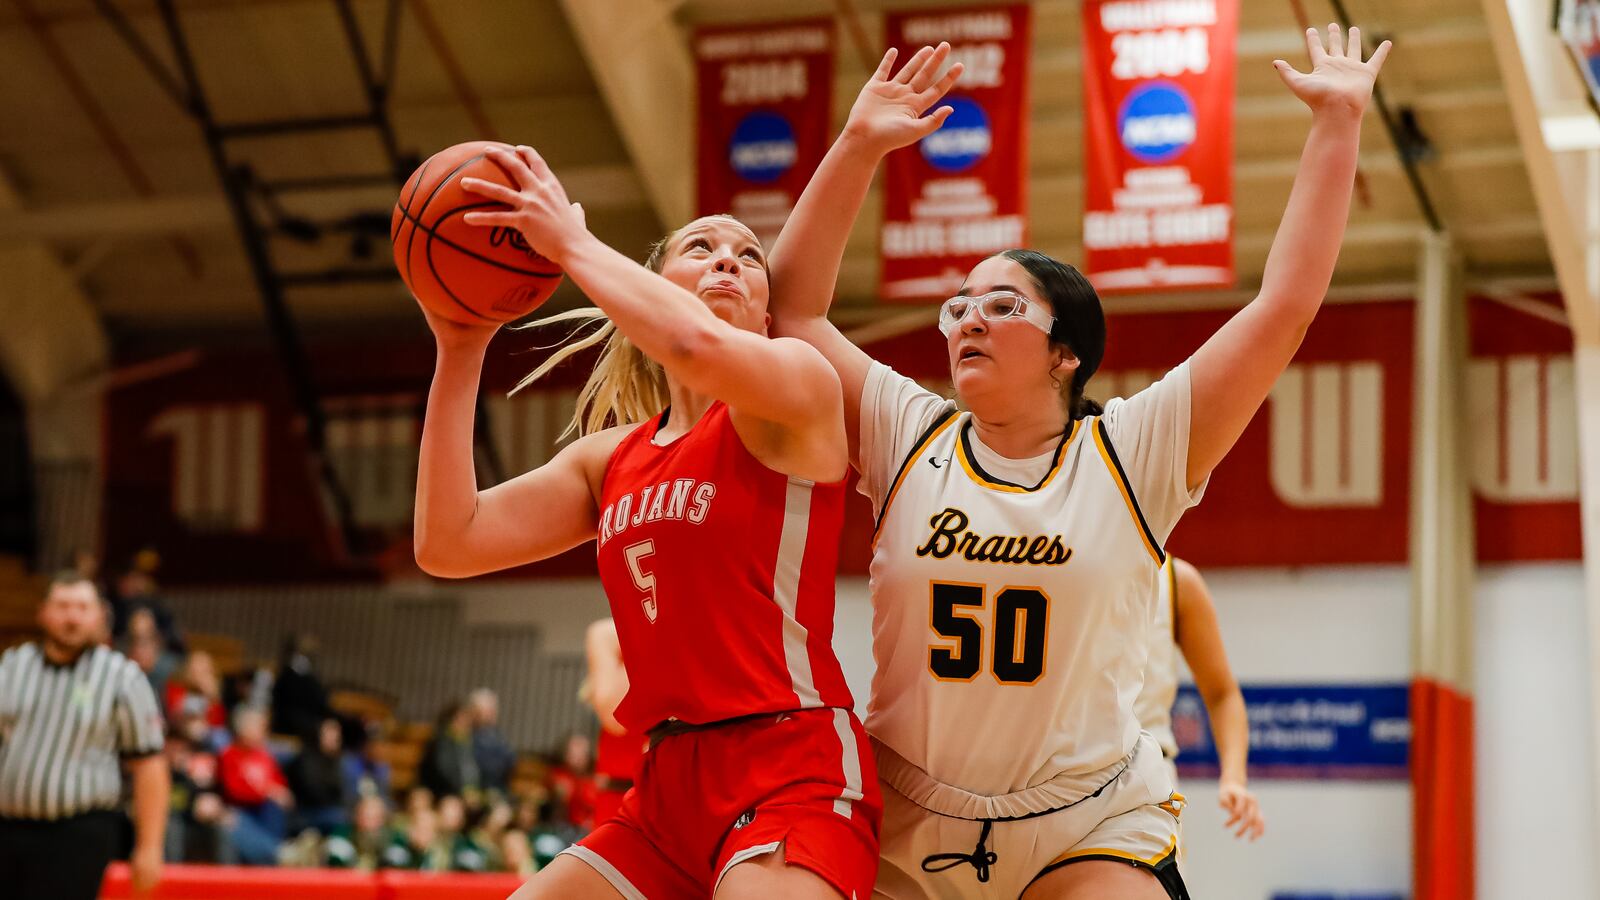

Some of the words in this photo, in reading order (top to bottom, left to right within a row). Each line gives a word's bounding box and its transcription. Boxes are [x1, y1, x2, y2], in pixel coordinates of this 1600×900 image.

[597, 478, 717, 552] ROJANS
[916, 507, 1073, 566] Braves
[623, 537, 658, 625] 5
[927, 579, 1052, 687] 50
